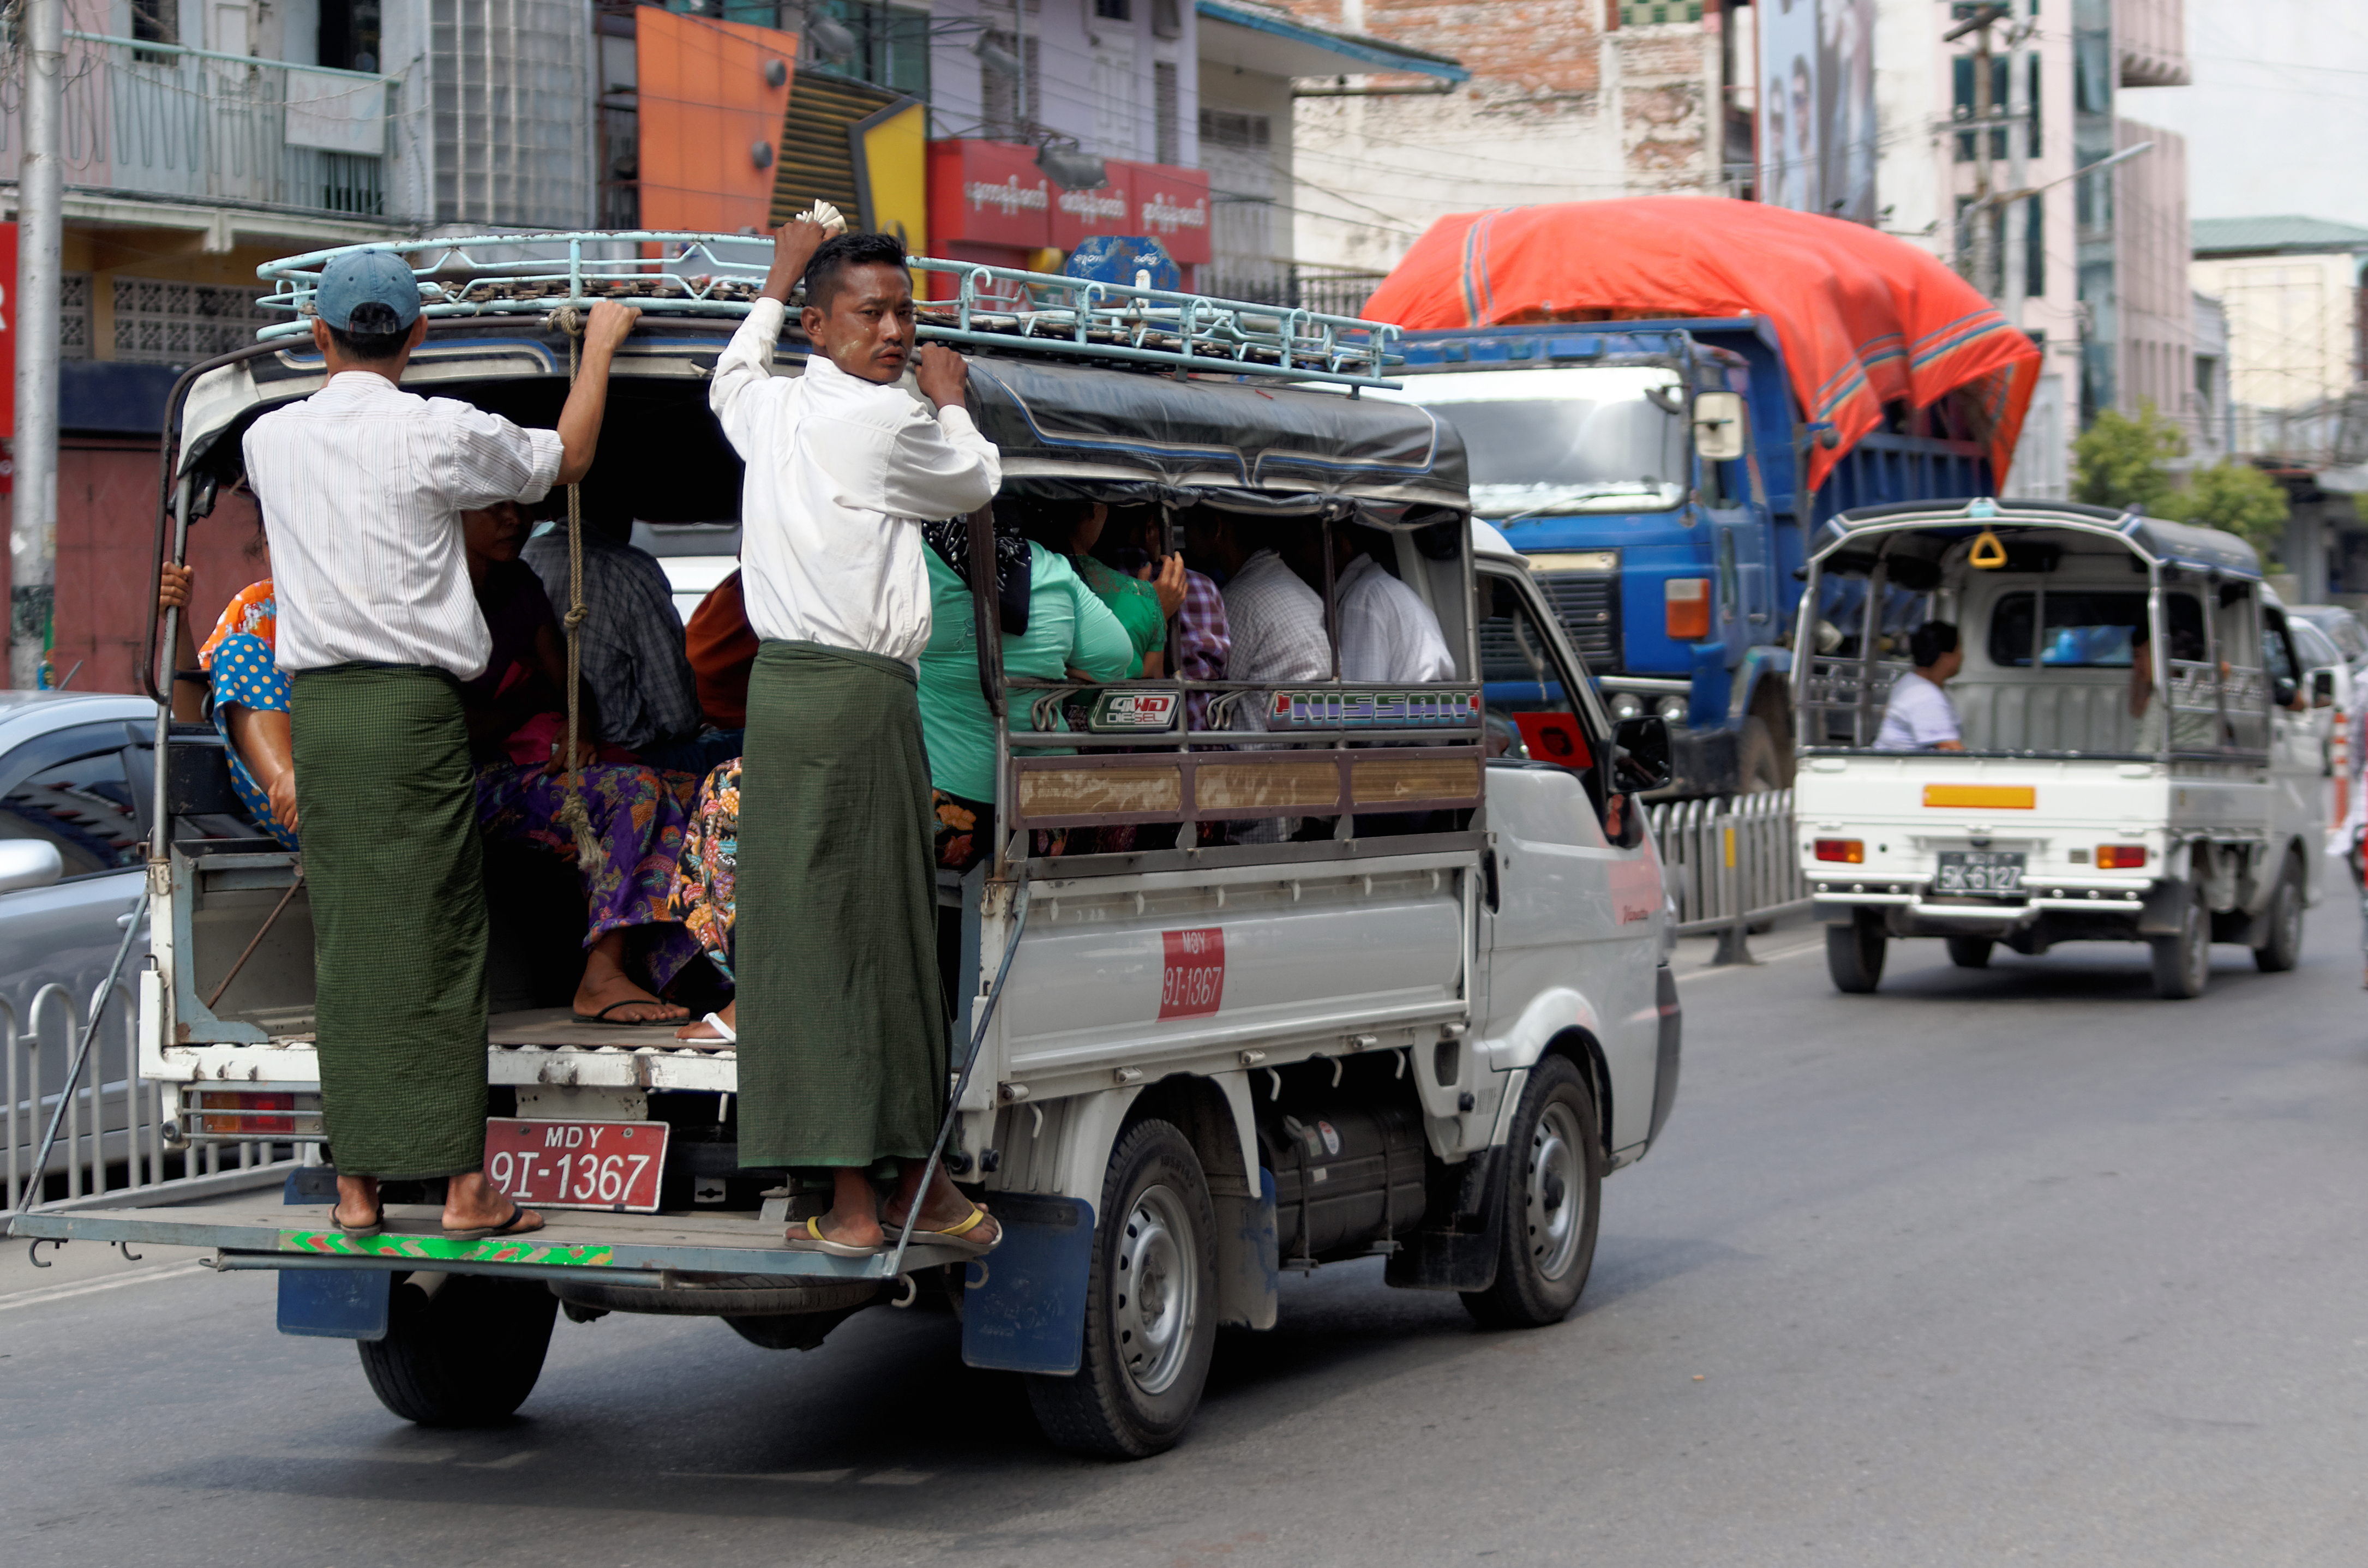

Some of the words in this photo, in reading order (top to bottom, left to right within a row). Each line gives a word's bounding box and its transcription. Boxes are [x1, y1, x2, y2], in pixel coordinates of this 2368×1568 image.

[1107, 712, 1163, 723] DIESEL
[1291, 693, 1468, 722] NISSAN
[1941, 864, 2022, 890] 5K-6127
[1163, 966, 1222, 1006] 9I-1367
[544, 1126, 604, 1149] MDY
[490, 1151, 651, 1201] 9I-1367
